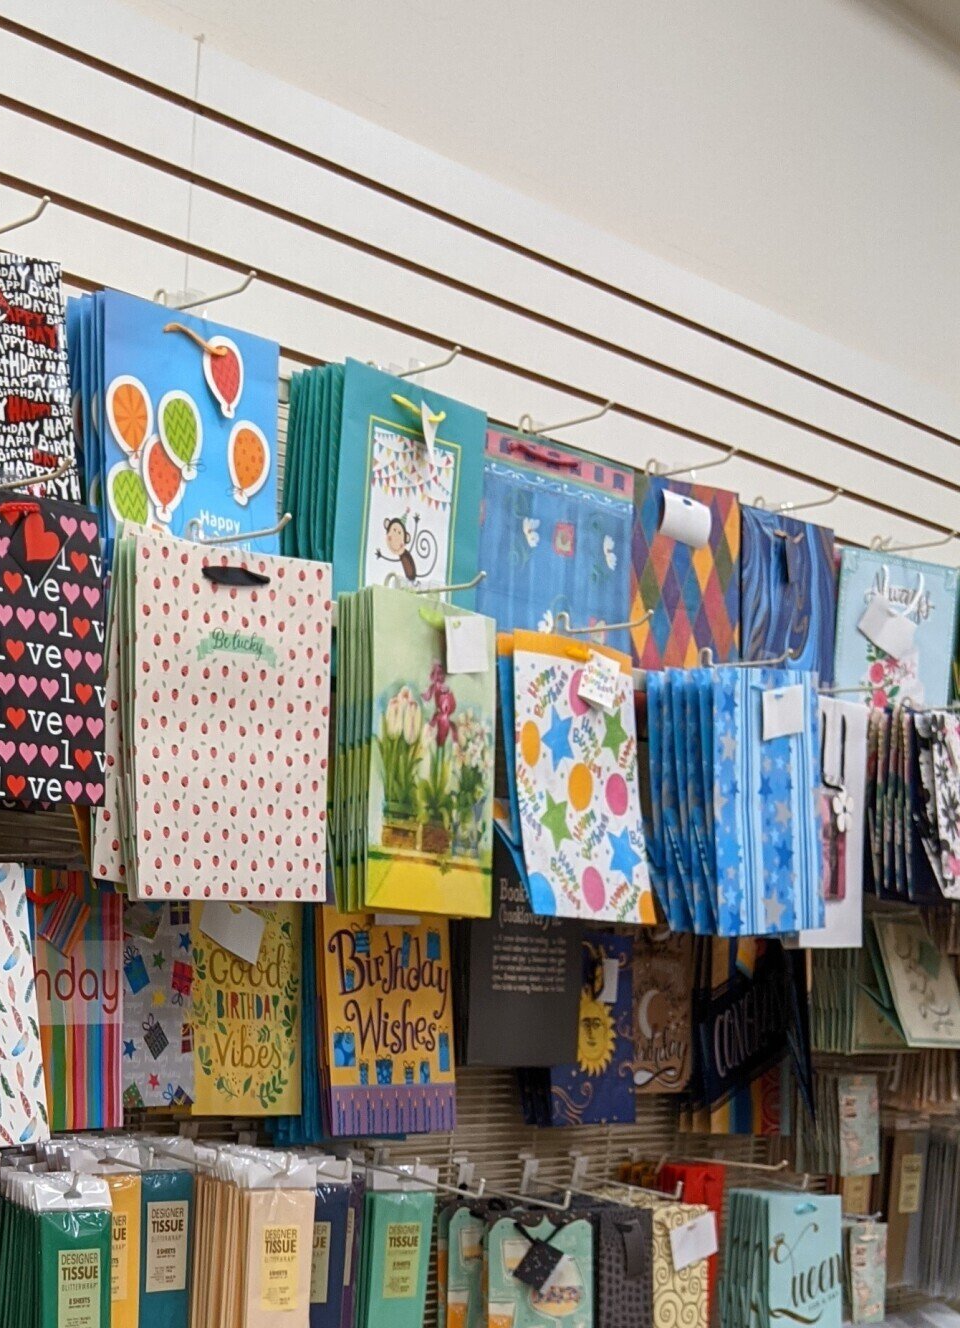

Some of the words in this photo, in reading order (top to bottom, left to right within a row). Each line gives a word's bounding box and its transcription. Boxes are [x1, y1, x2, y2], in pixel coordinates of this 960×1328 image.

[200, 508, 242, 533] Happy
[210, 627, 232, 652] Be
[232, 629, 266, 661] lucky
[210, 944, 285, 989] Good
[329, 927, 450, 1020] Birthday
[216, 988, 281, 1021] BIRTHDAY
[344, 997, 438, 1056] Wishes
[213, 1025, 282, 1070] Vibes
[151, 1207, 184, 1219] DESIGNER
[151, 1219, 184, 1234] TISSUE
[264, 1228, 297, 1241] DESIGNER
[61, 1252, 98, 1266] DESIGNER
[264, 1240, 297, 1254] TISSUE
[61, 1266, 99, 1281] TISSUE
